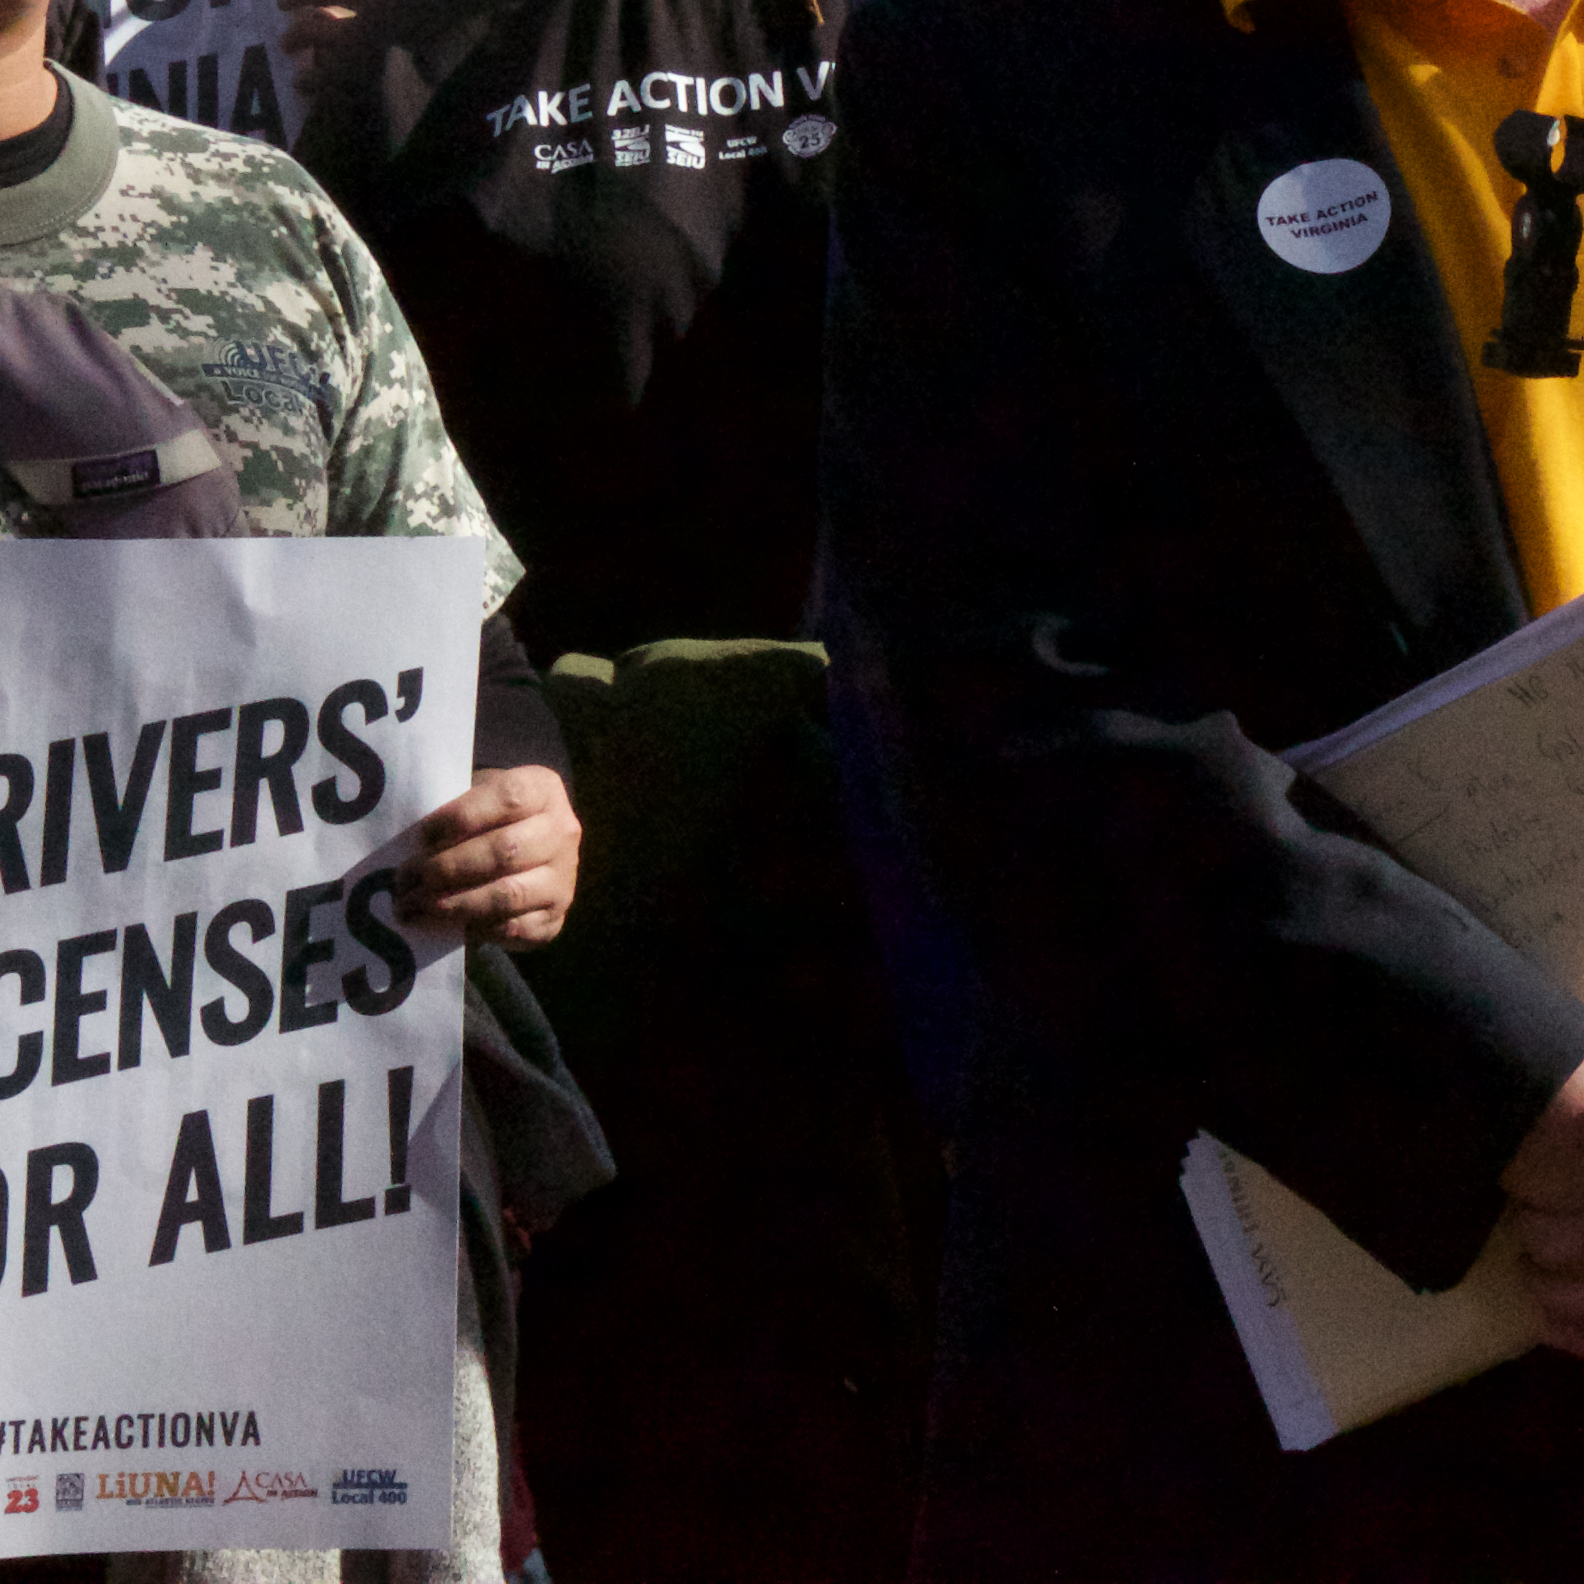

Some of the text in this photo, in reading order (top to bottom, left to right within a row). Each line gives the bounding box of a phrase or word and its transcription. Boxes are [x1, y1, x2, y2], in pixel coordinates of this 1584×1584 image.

[486, 60, 835, 138] TAKE ACTION V
[533, 138, 594, 161] CASA
[666, 153, 705, 169] SEIU
[718, 149, 747, 160] Local
[1265, 191, 1379, 227] TAKE ACTION
[1290, 213, 1369, 239] VIRGINIA
[150, 1065, 415, 1268] ALL!
[96, 1469, 216, 1500] LiUNA!
[254, 1471, 308, 1490] CASA
[342, 1469, 397, 1484] UFCW
[4, 1487, 40, 1515] 23
[331, 1489, 374, 1504] Local
